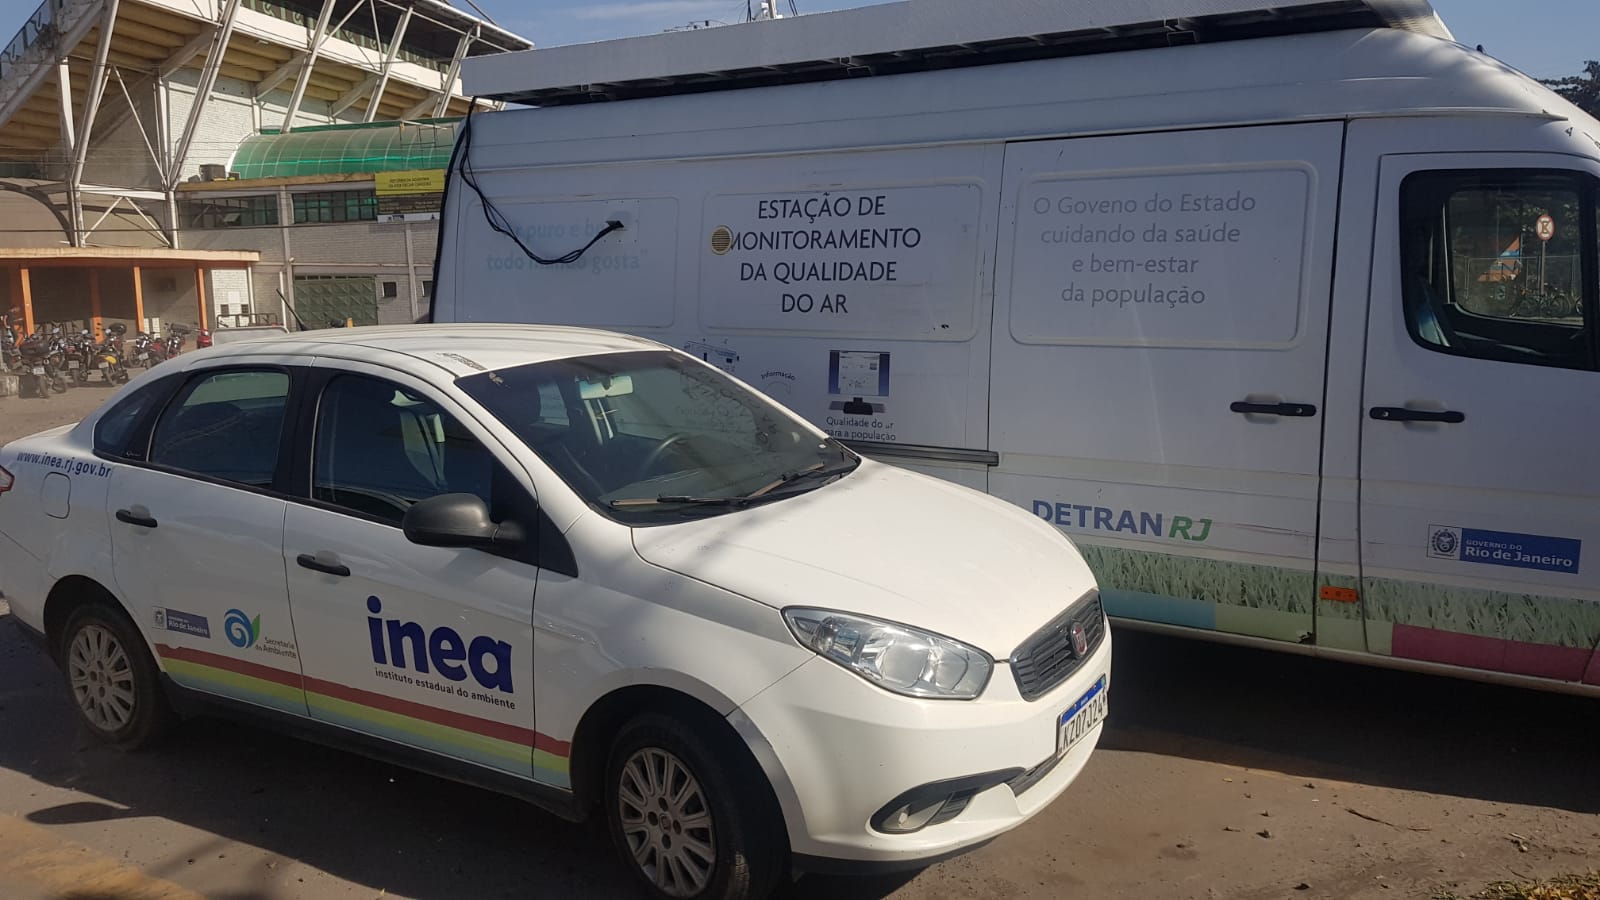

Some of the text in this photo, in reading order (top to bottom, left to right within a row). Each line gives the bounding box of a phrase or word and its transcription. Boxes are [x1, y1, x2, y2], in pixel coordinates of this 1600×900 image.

[758, 192, 886, 223] ESTAÇÃO DE
[1033, 190, 1257, 214] O Goveno do Estado
[1040, 221, 1241, 243] cuidando da saúde
[740, 261, 897, 284] DA QUALIDADE
[1071, 252, 1199, 273] e bem-estar
[781, 293, 848, 313] DO AR
[1061, 281, 1206, 309] da população
[826, 416, 870, 427] Qualidade
[871, 418, 883, 429] do
[851, 430, 896, 441] população
[16, 451, 112, 478] www.inea.rj.gov.br
[1032, 499, 1213, 542] DETRAN RJ
[1465, 539, 1522, 551] GOVERNO DO
[1465, 546, 1573, 567] Rio de Janeiro
[366, 595, 514, 694] inea
[374, 667, 516, 710] instituto estadual do ambiente
